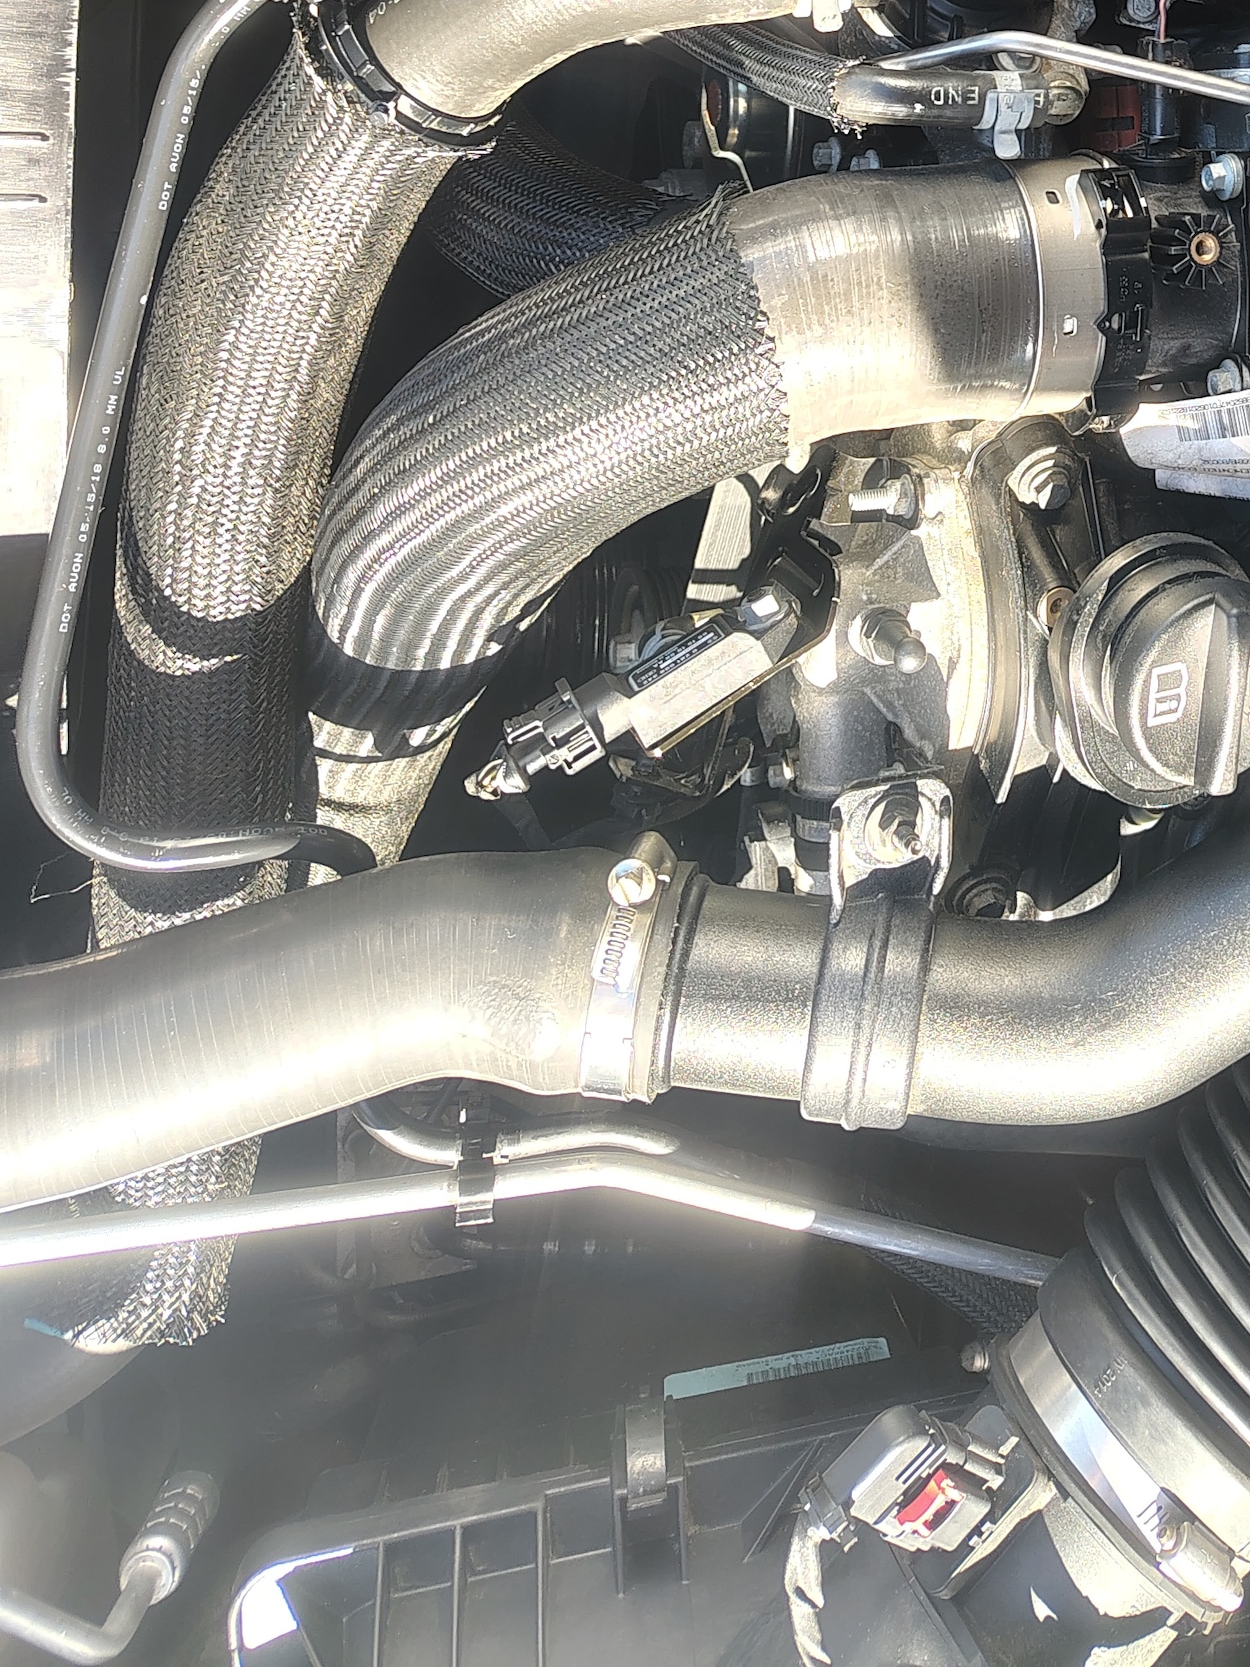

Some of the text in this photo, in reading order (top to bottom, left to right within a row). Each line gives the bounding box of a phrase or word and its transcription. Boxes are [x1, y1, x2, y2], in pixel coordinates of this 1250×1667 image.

[931, 85, 979, 104] END
[156, 180, 175, 211] DOT
[167, 132, 186, 172] AVON
[56, 601, 74, 633] DOT
[66, 551, 85, 593] AVON
[96, 424, 112, 454] 8.0
[105, 393, 119, 415] MM
[112, 364, 126, 385] UL
